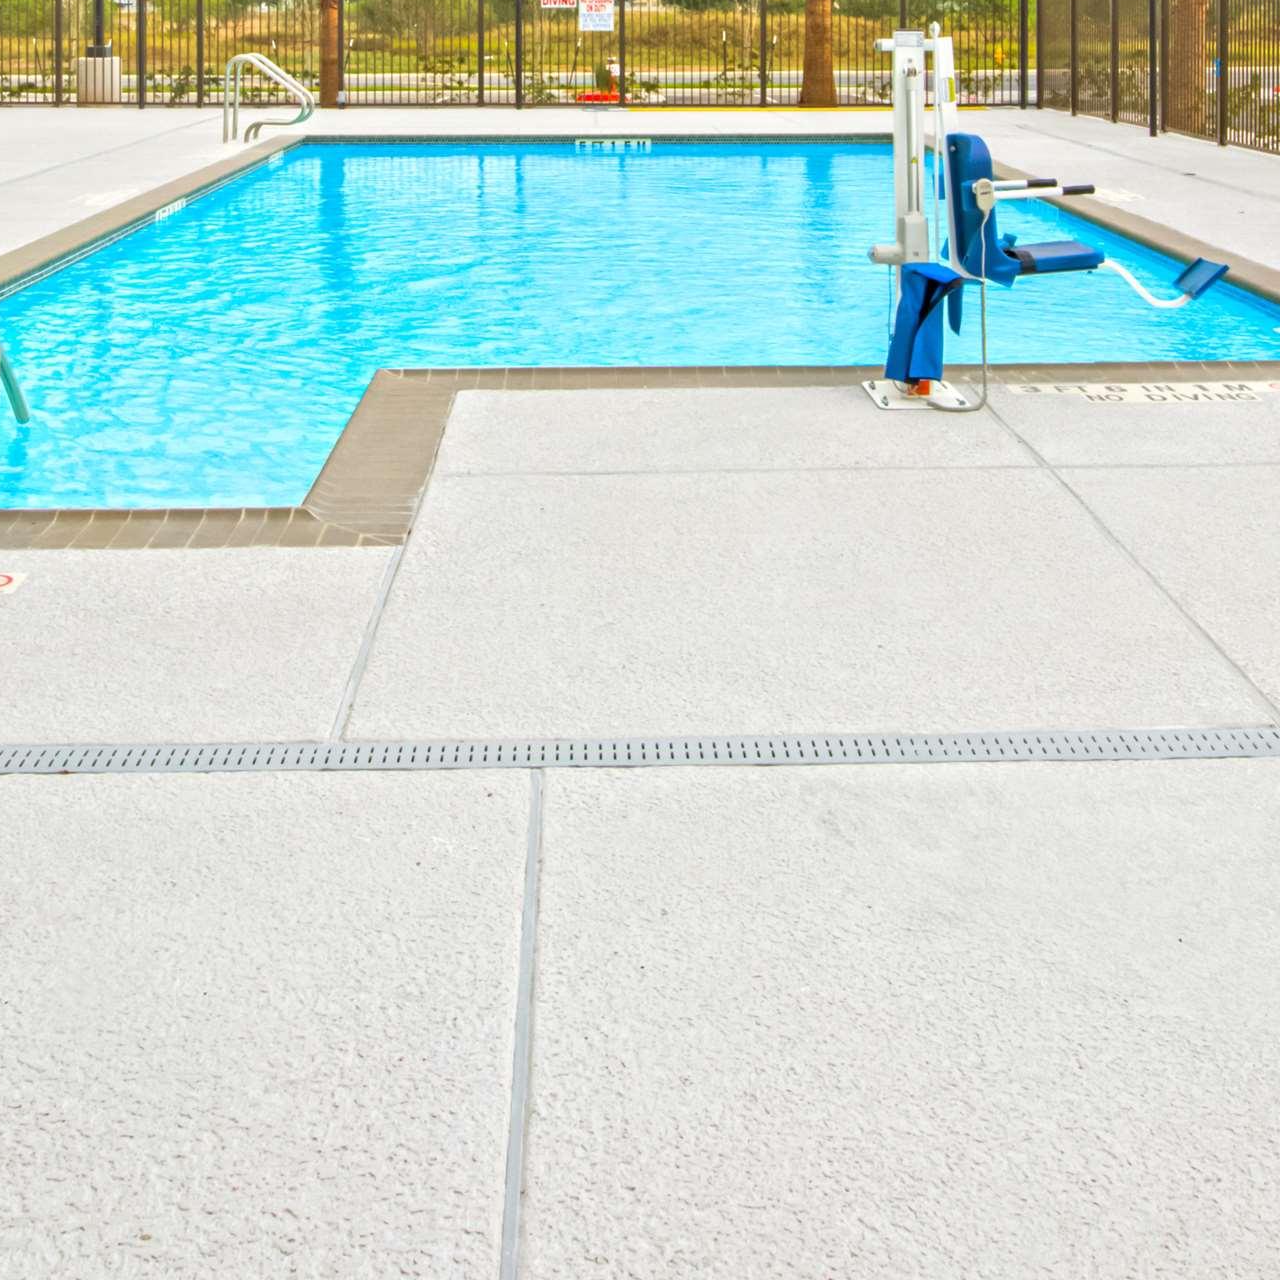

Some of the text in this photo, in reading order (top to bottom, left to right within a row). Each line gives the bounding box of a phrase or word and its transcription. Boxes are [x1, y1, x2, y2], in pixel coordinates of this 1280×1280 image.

[1020, 385, 1041, 393] 3
[1054, 385, 1087, 393] FT
[1144, 393, 1257, 401] DIVING
